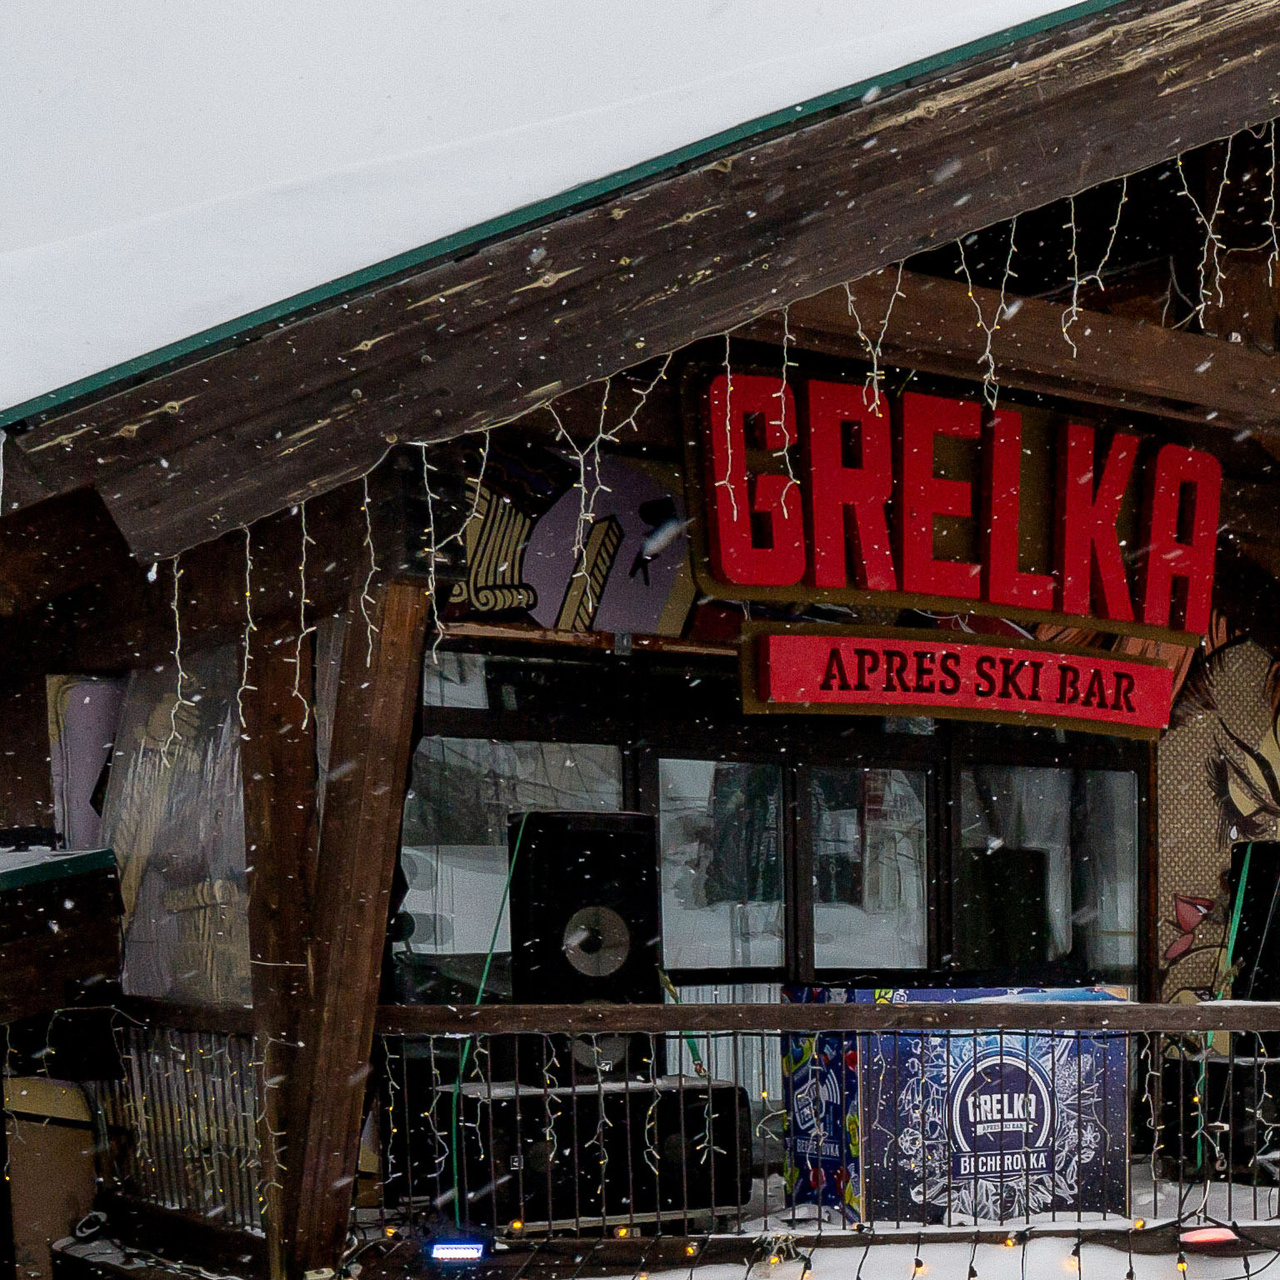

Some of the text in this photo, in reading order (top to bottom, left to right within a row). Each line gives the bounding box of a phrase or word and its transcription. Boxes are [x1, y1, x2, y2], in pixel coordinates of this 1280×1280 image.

[709, 375, 1223, 636] GRELKA
[819, 647, 1137, 713] APRES SKI BAR
[967, 1093, 1037, 1122] GRELKA
[796, 1138, 840, 1157] BECHEOVKA
